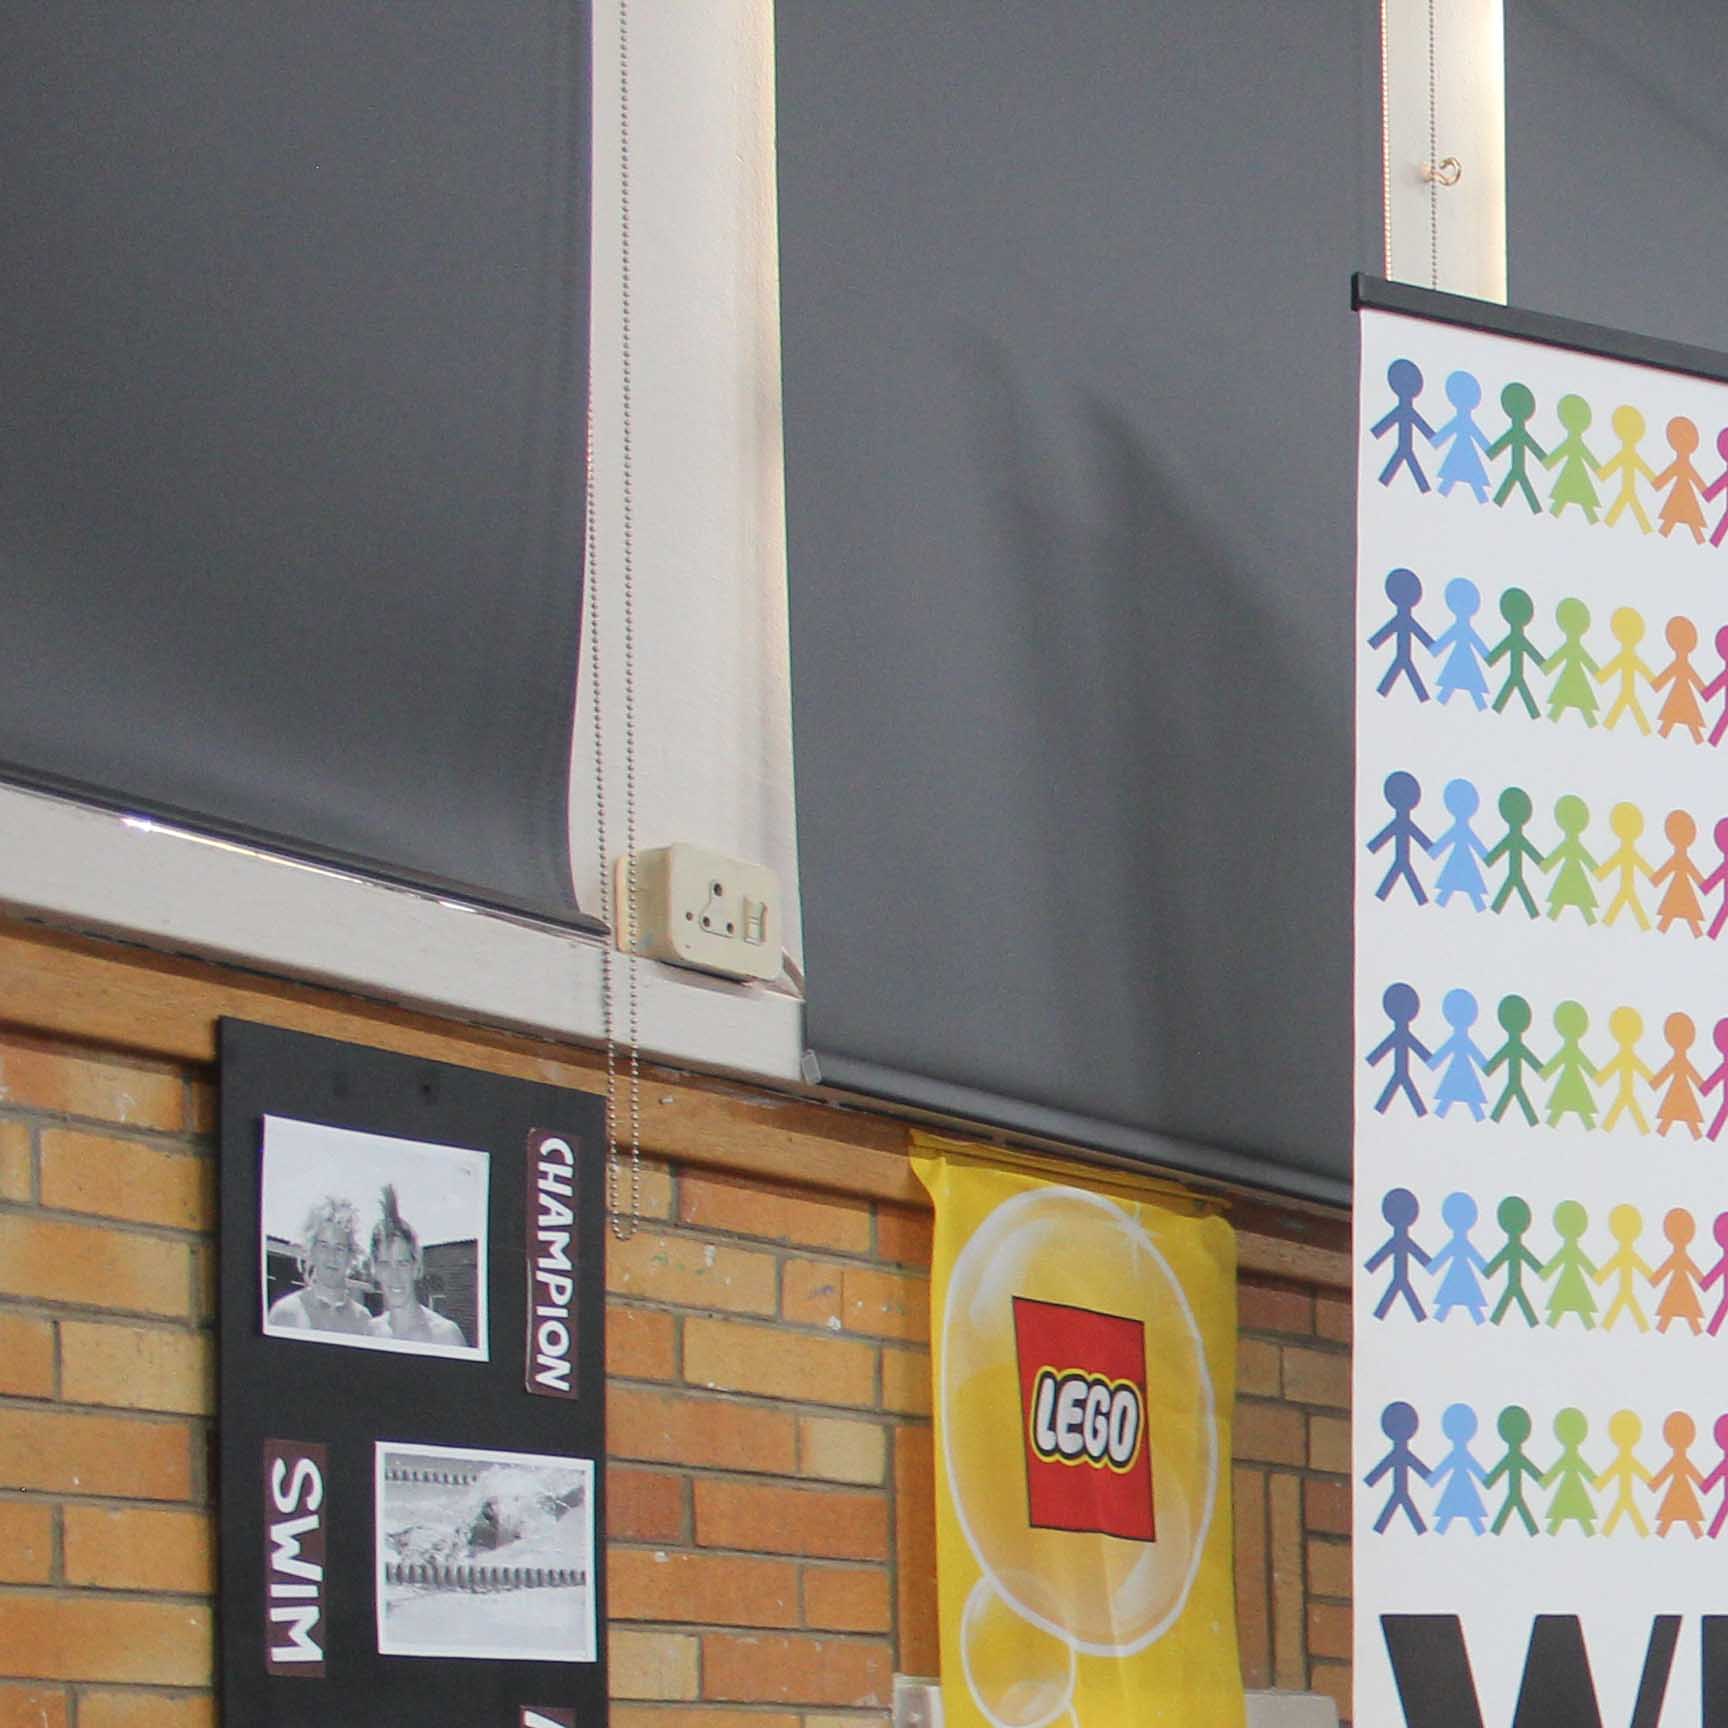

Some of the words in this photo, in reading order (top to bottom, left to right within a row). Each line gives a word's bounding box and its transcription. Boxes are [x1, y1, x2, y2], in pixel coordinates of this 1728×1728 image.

[538, 1136, 574, 1392] CHAMPION
[1035, 1370, 1143, 1468] LEGO
[268, 1456, 325, 1663] SWIM
